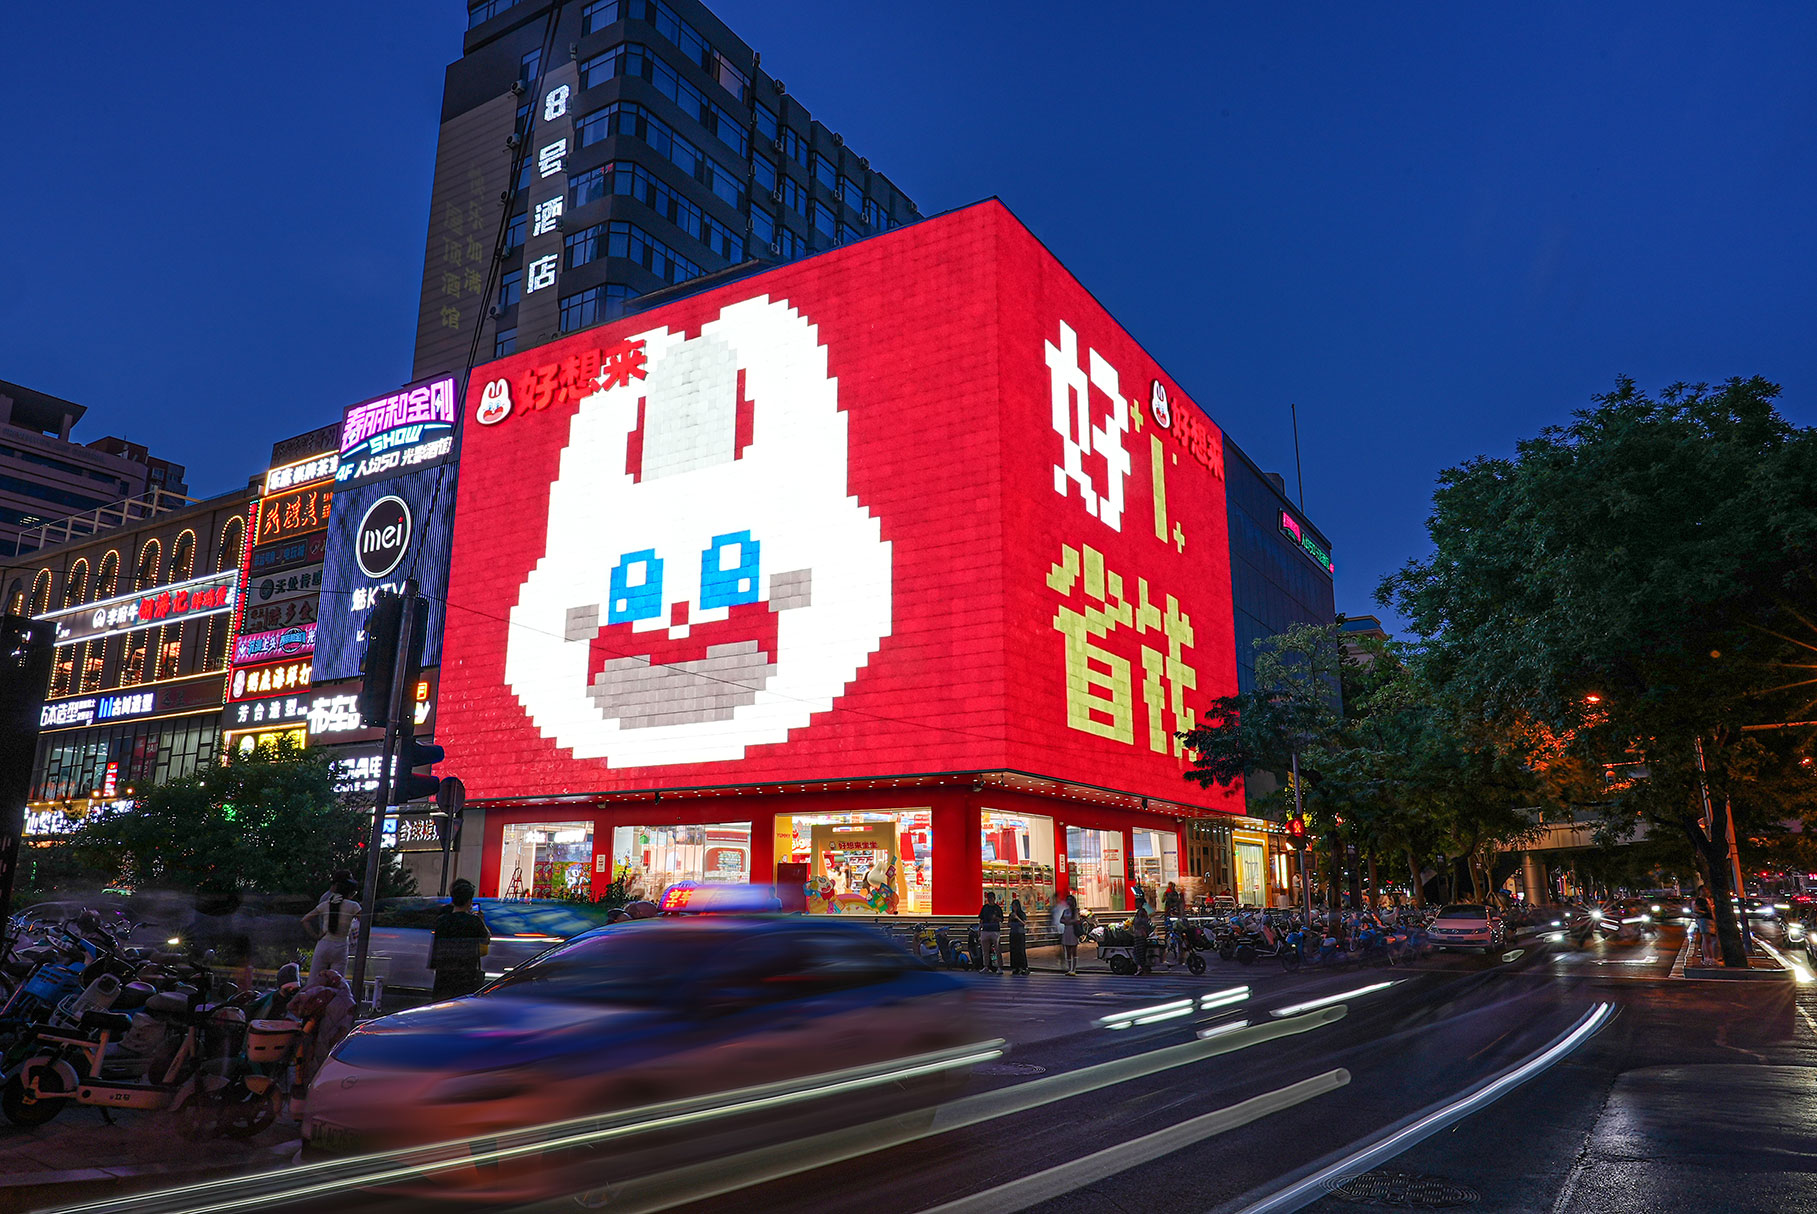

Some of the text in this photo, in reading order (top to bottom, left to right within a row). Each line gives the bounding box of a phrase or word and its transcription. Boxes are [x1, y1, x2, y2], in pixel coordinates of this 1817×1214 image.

[526, 84, 570, 294] 8号酒店
[519, 339, 649, 416] 好想来
[369, 424, 424, 455] SHOW
[1045, 320, 1132, 533] 好
[1171, 397, 1224, 482] 好想来
[335, 463, 355, 481] 4F
[363, 516, 404, 553] mei
